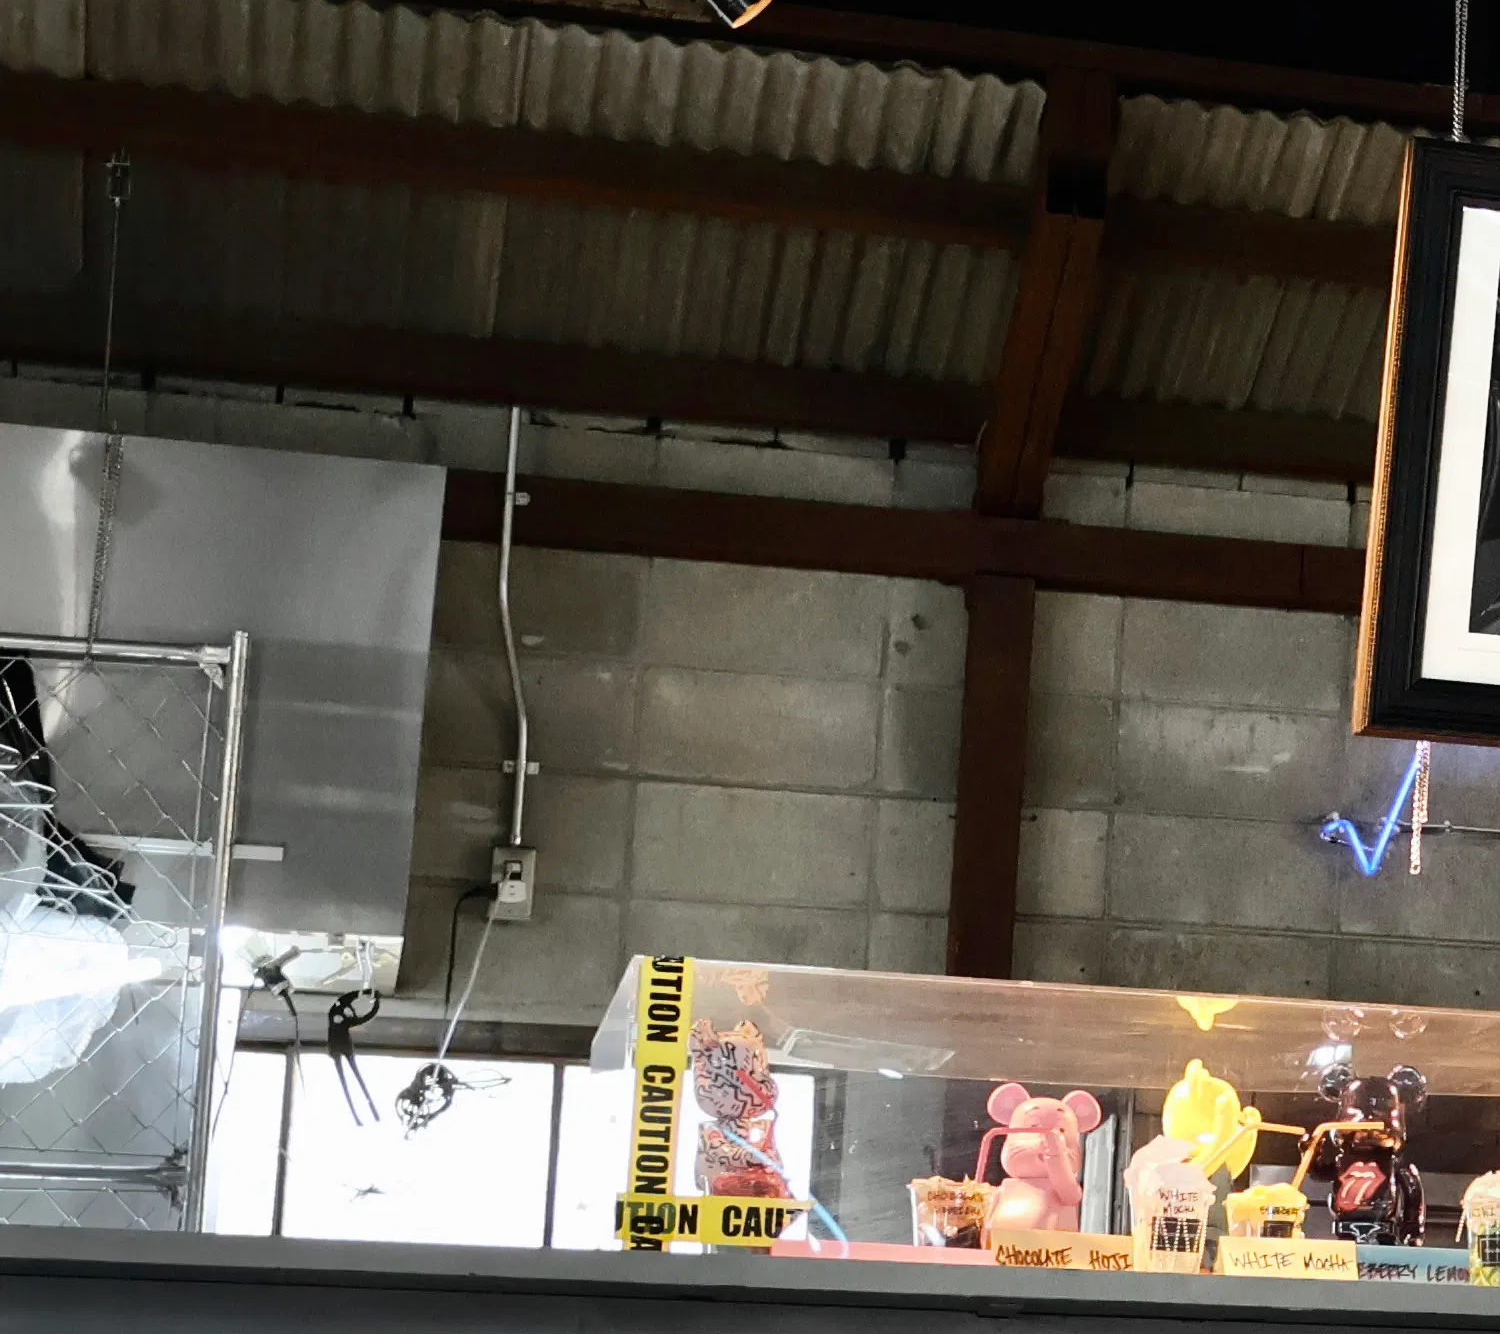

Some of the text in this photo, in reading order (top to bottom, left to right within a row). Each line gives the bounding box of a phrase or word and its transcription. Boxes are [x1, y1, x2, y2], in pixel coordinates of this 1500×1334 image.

[634, 1064, 675, 1194] CAUTION
[1160, 1188, 1199, 1203] WHITE
[995, 1244, 1072, 1267] CHOCOLATE
[1230, 1252, 1354, 1271] WHITE MOCHA
